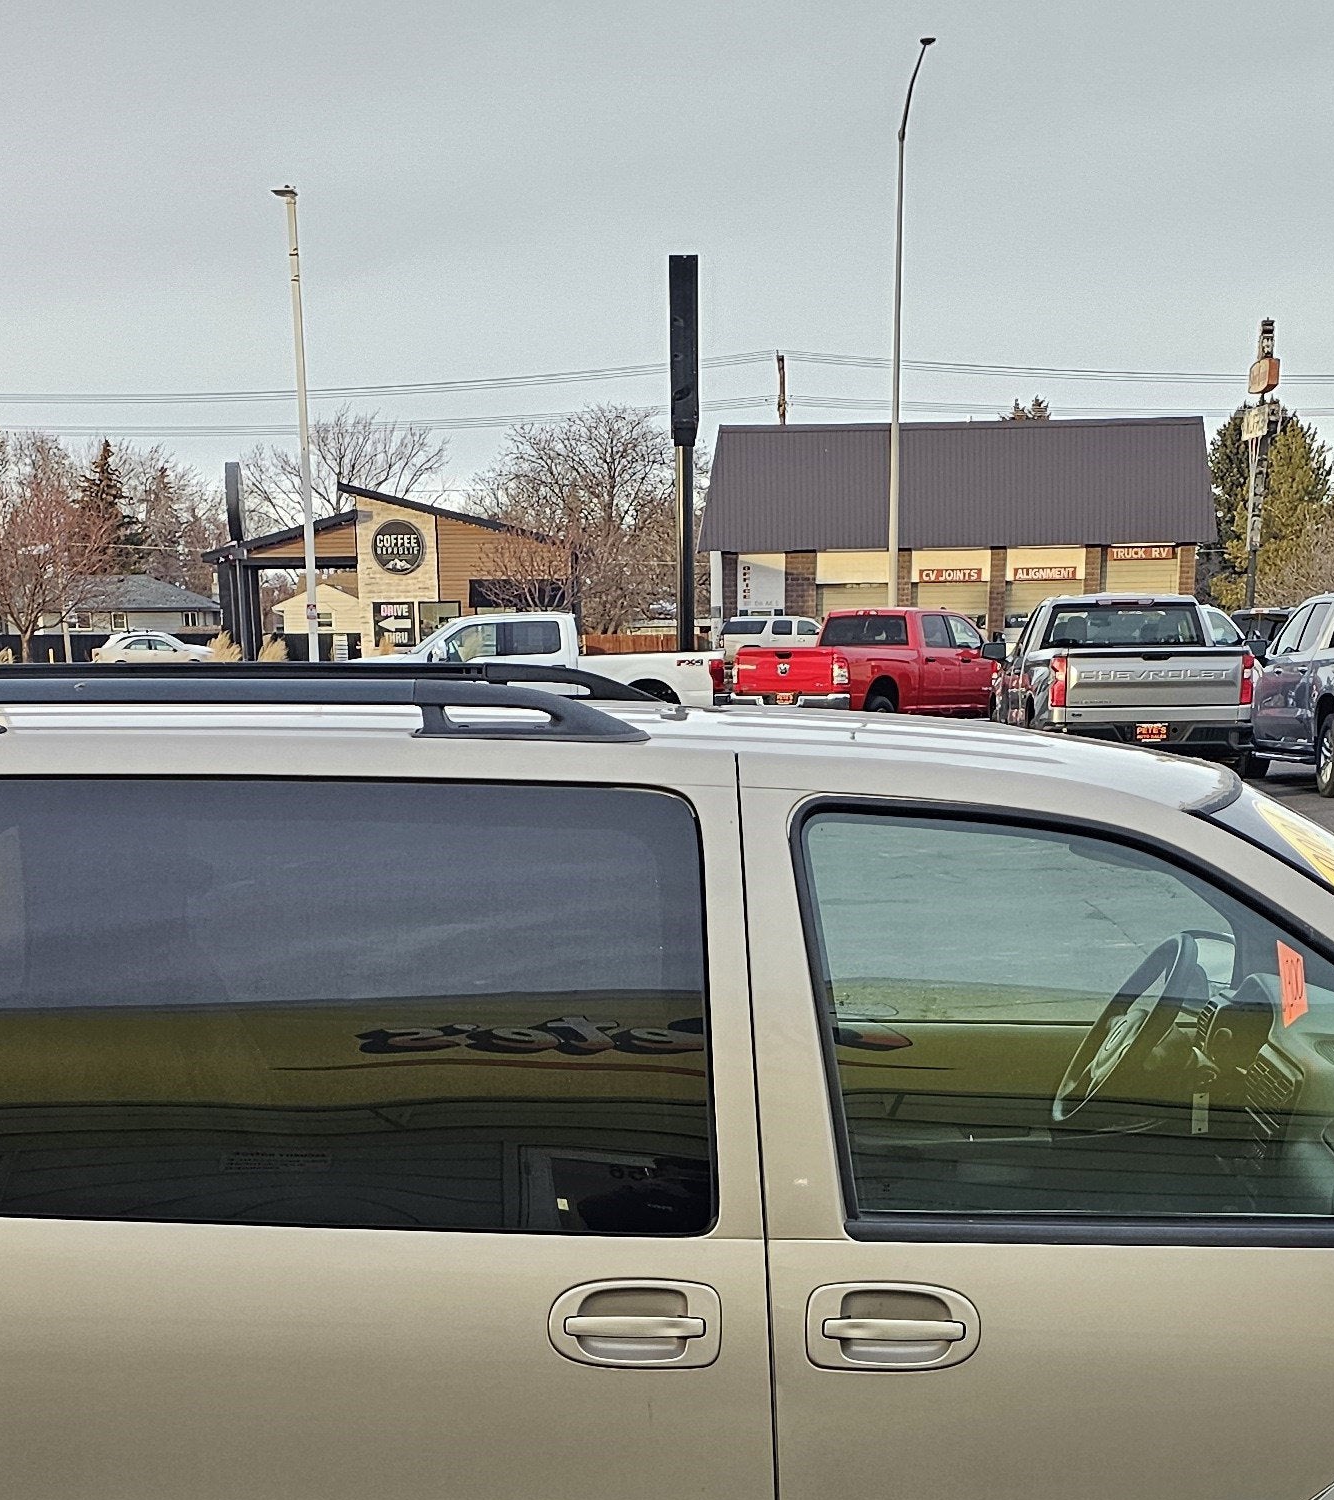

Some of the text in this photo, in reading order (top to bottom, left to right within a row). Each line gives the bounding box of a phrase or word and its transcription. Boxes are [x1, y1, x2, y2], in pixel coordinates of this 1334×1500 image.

[376, 534, 418, 547] COFFEE
[1112, 547, 1169, 559] TRUCK RV
[922, 569, 978, 581] CV JOINTS
[1016, 567, 1075, 580] ALIGNMENT
[380, 604, 409, 616] DRIVE
[384, 632, 408, 643] THRU
[1080, 669, 1231, 681] CHEVROLET
